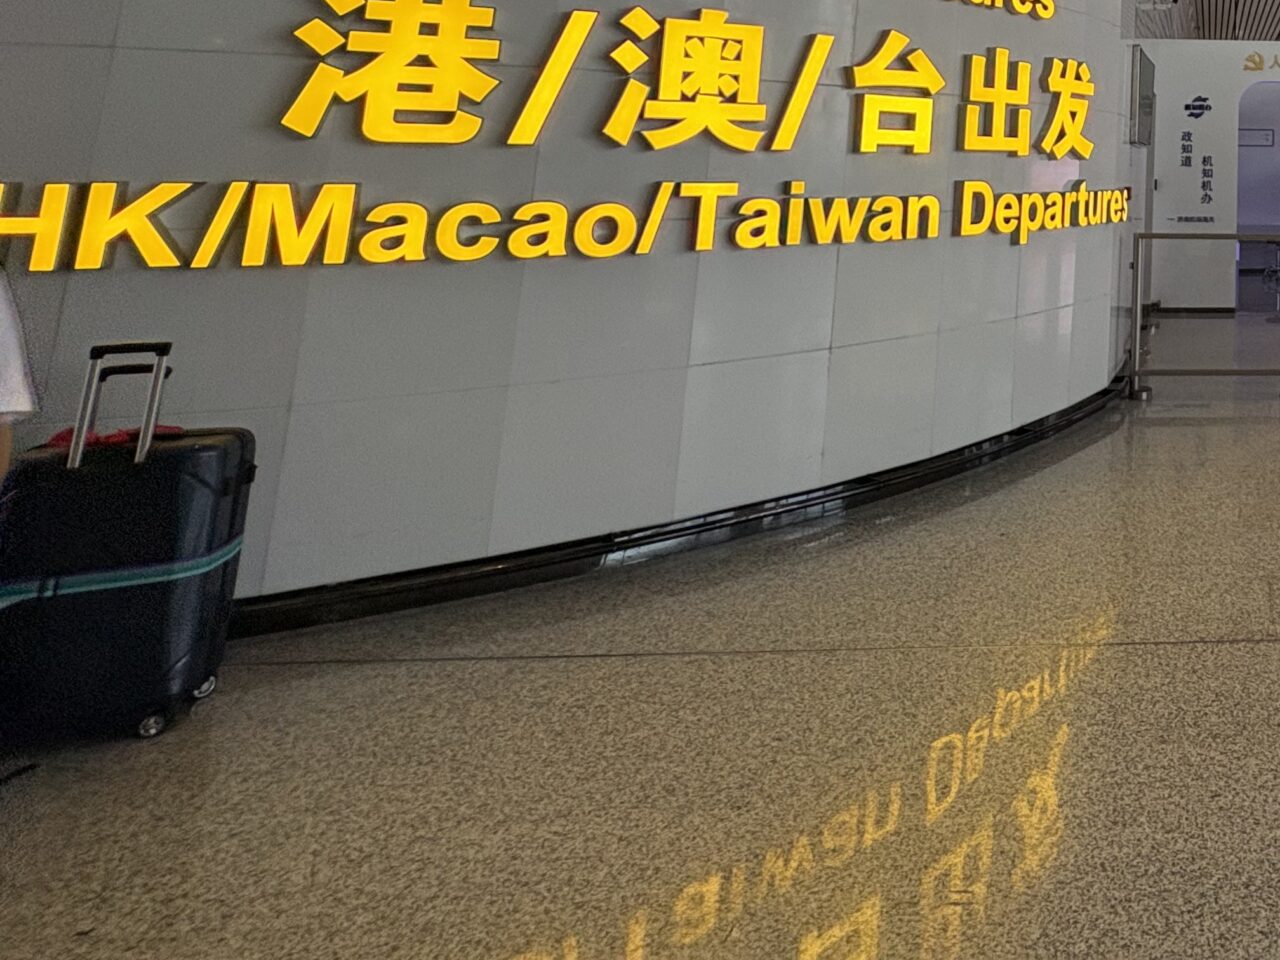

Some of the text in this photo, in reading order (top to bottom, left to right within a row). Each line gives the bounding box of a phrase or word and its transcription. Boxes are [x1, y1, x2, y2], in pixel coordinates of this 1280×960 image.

[1180, 130, 1193, 168] 政知道
[0, 181, 1129, 272] HK/Macao/Taiwan Departures
